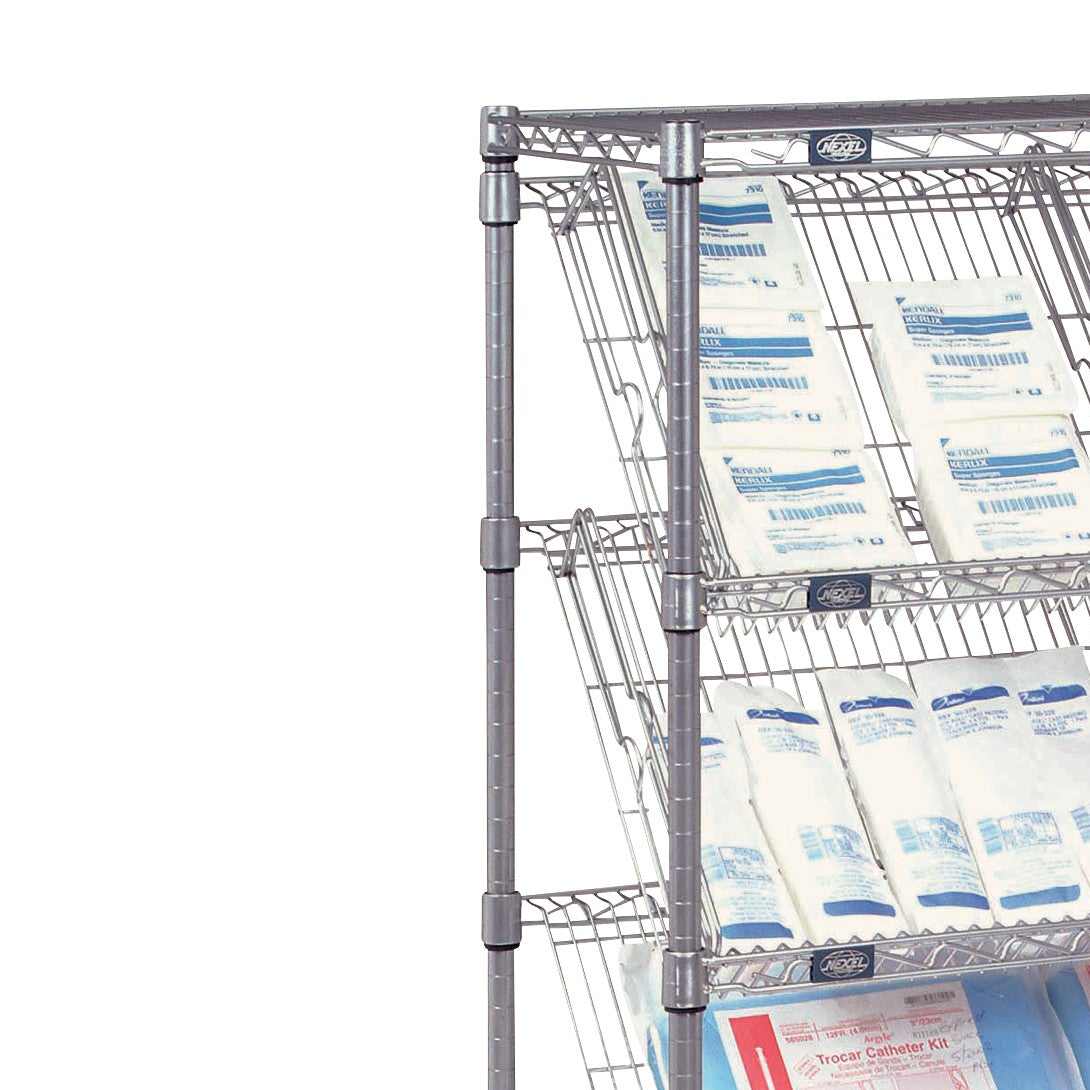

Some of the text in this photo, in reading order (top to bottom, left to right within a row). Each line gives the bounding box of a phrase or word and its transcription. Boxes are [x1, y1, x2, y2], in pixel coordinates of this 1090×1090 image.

[821, 140, 865, 154] NEXEL
[902, 305, 944, 314] KENDALL
[905, 316, 942, 325] KERLIX
[700, 326, 726, 335] DALL
[700, 338, 721, 347] RLIX
[949, 459, 989, 469] KERLIX
[734, 476, 773, 485] KERLIX
[823, 587, 863, 600] NEXEL
[822, 958, 867, 971] NEXEL
[864, 1031, 892, 1044] Argyle
[815, 1037, 949, 1065] Trocar Catheter Kit
